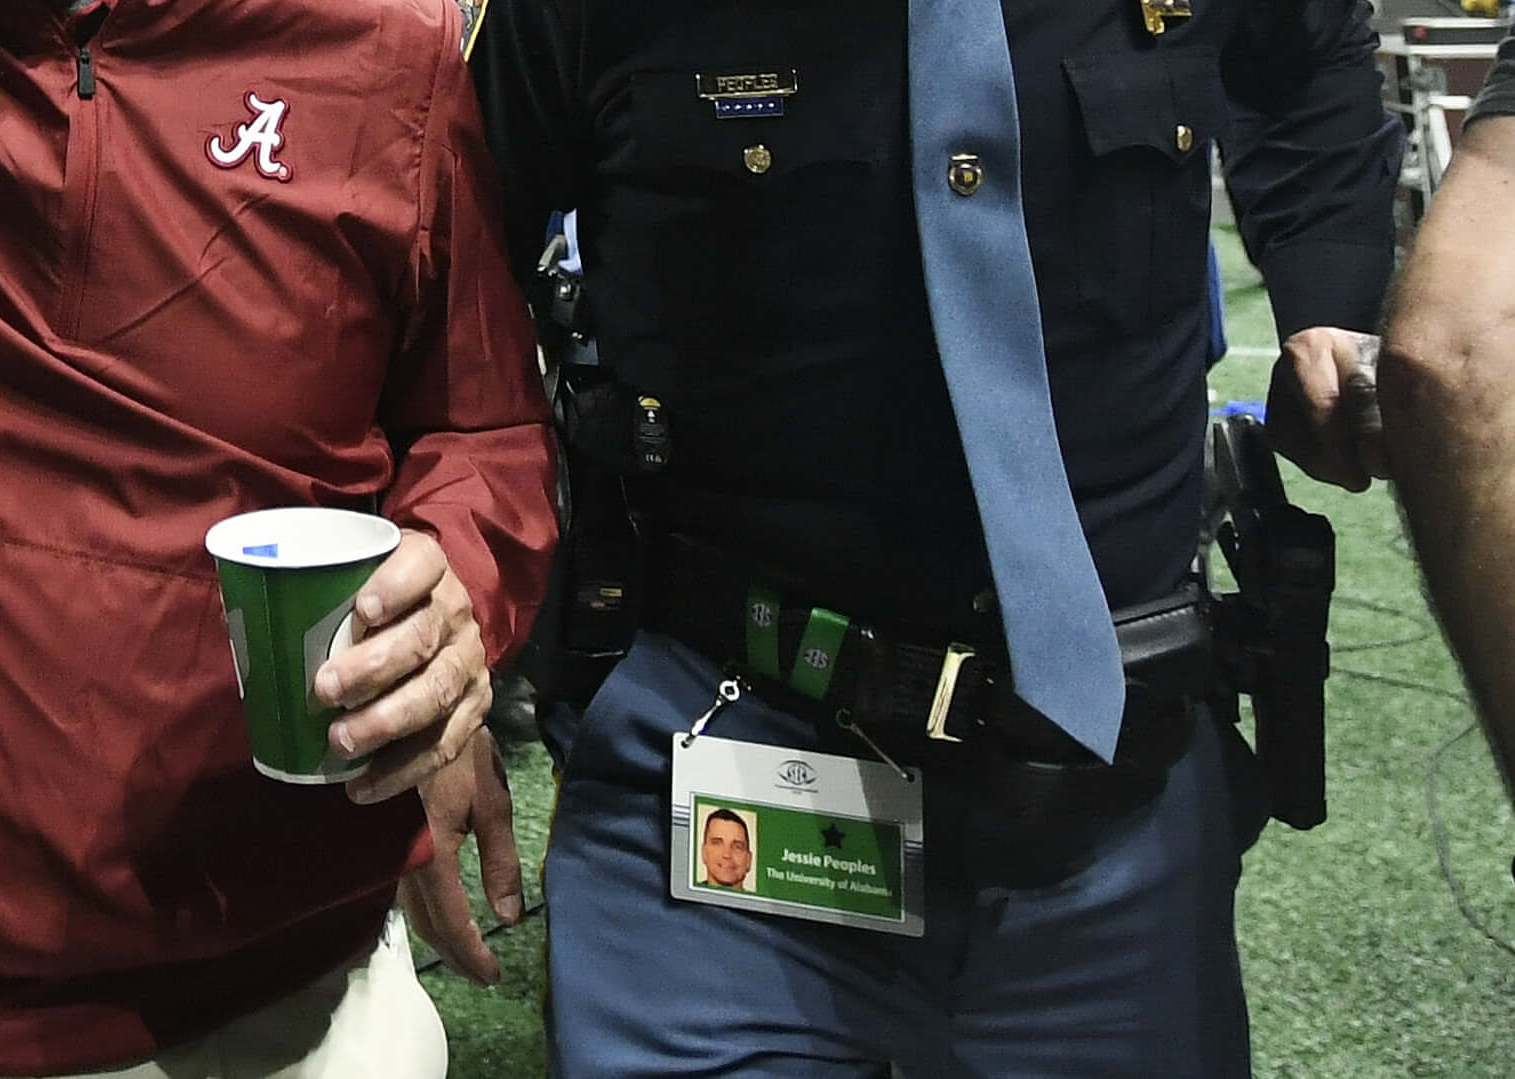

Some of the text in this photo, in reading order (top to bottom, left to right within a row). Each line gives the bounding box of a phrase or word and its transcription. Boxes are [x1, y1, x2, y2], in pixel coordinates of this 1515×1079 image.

[780, 848, 877, 876] Jessie Peoples
[766, 866, 786, 881] The
[785, 870, 836, 890] University
[836, 879, 848, 890] of
